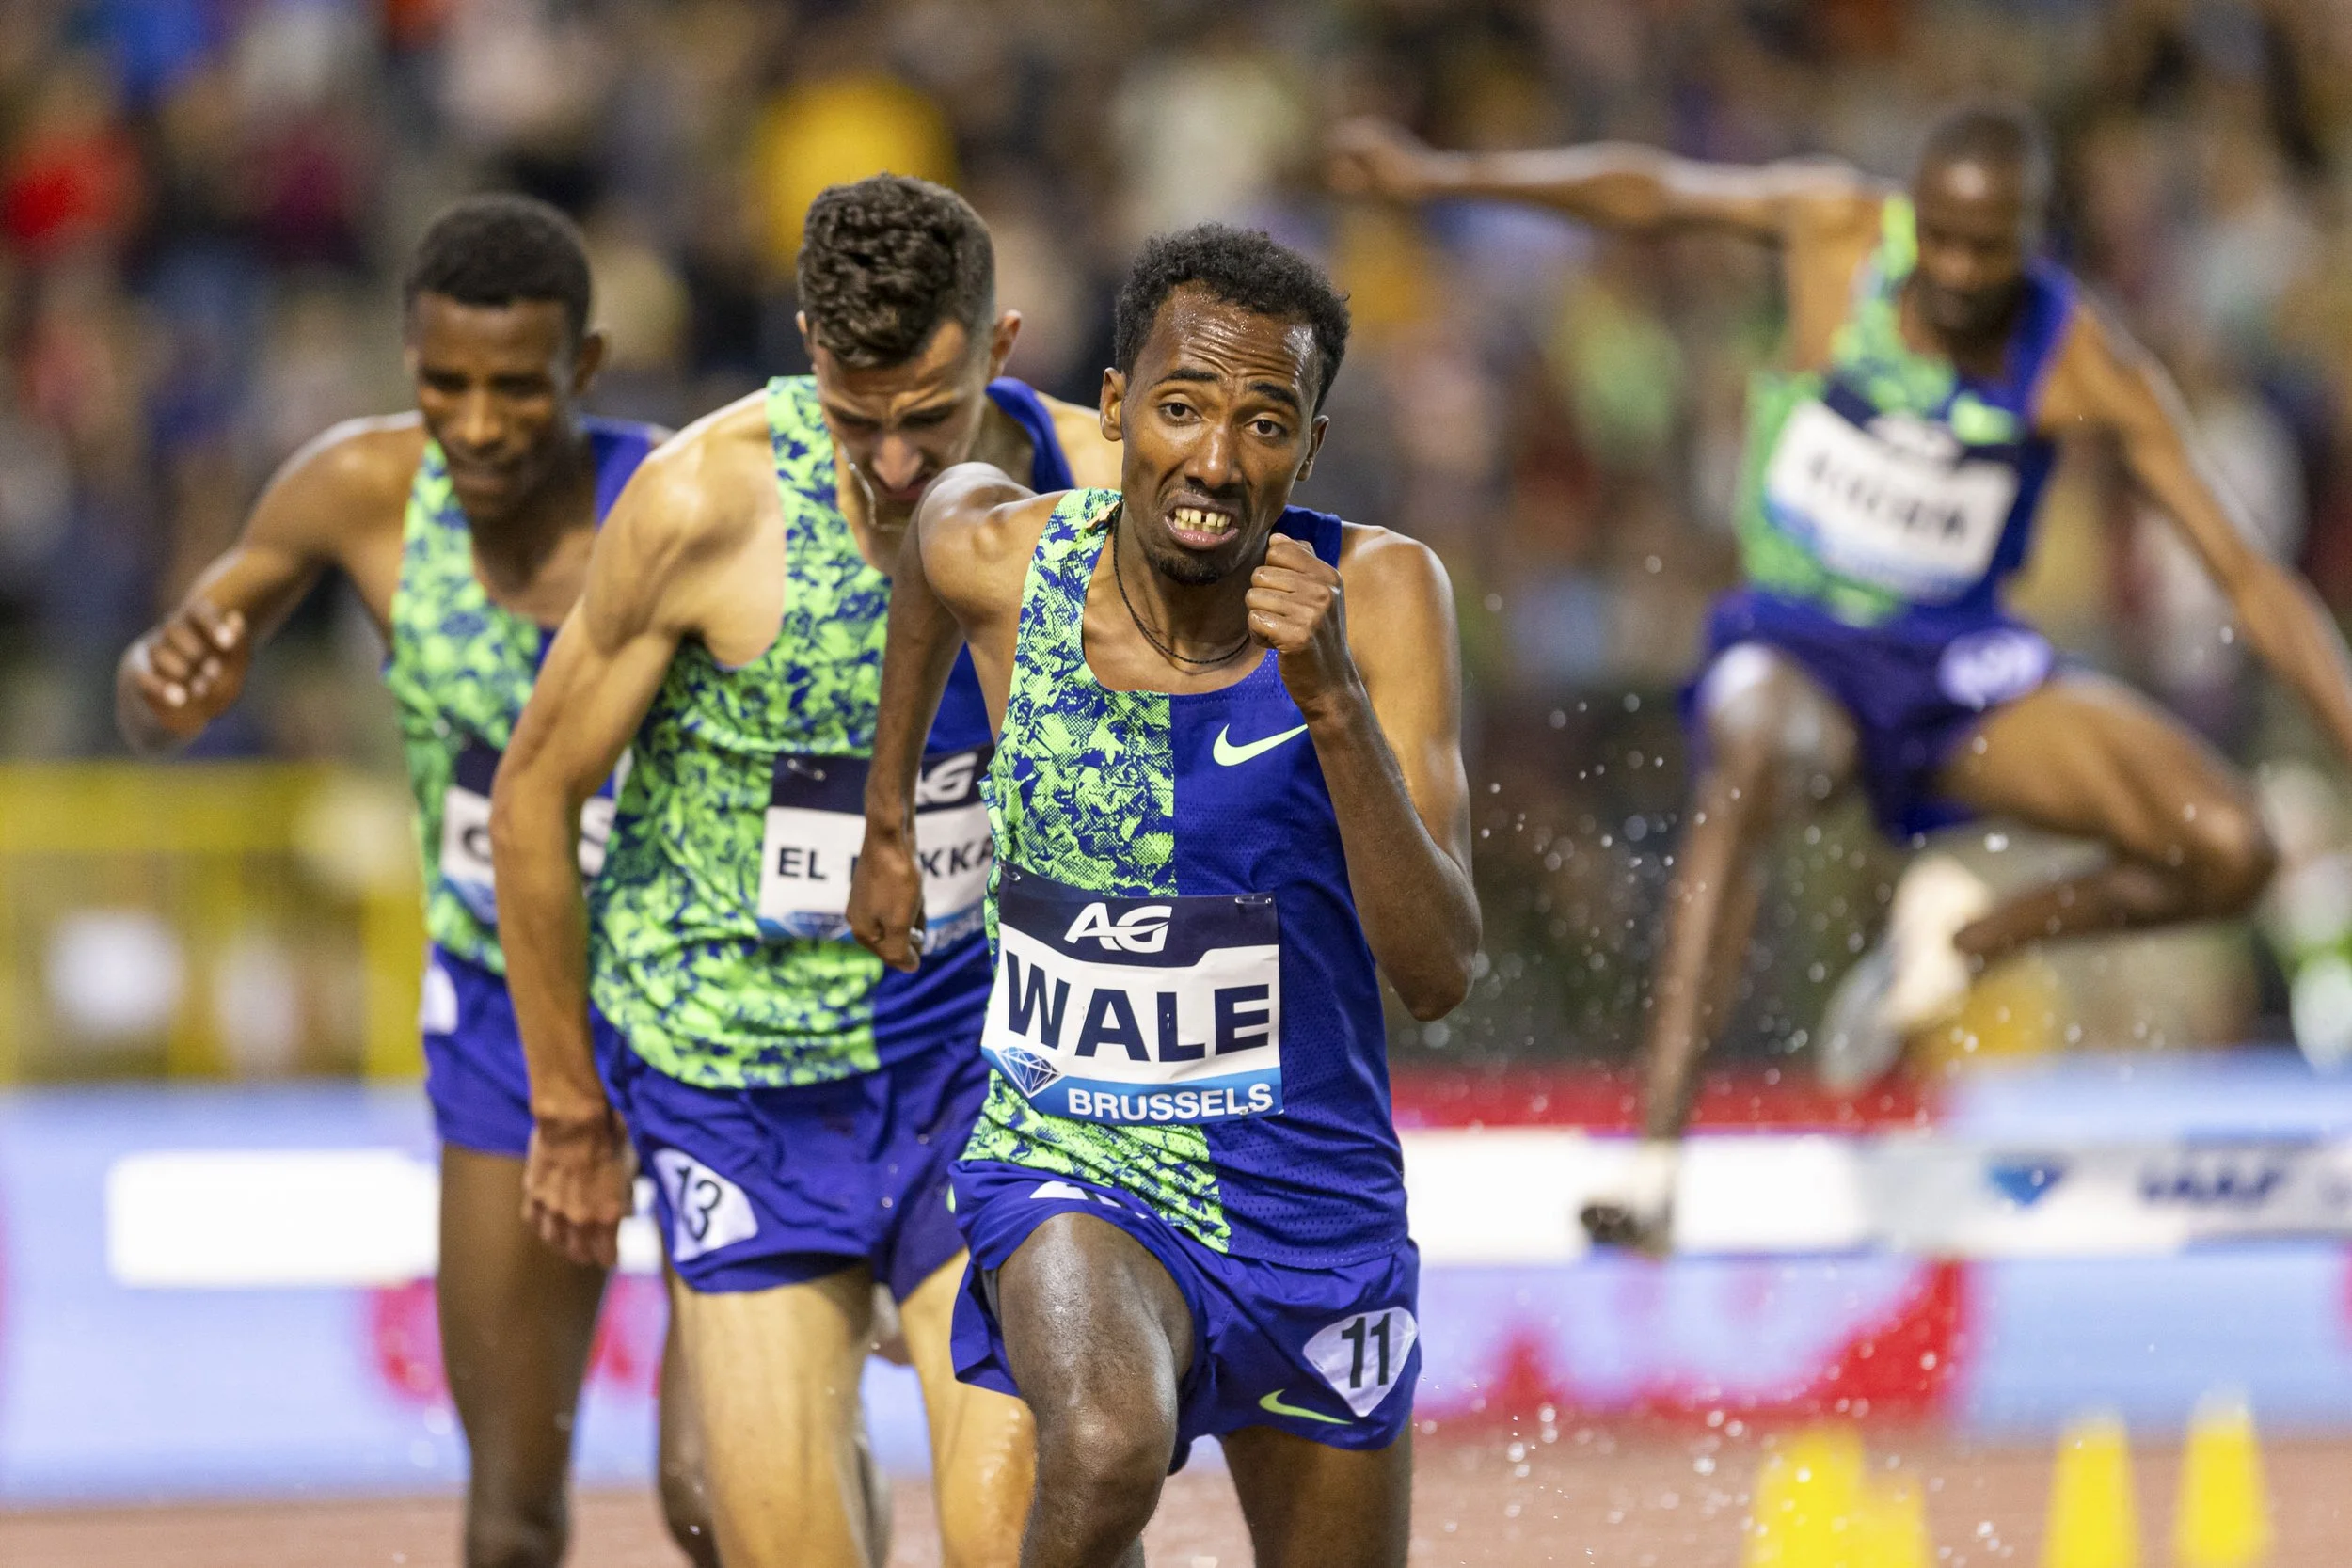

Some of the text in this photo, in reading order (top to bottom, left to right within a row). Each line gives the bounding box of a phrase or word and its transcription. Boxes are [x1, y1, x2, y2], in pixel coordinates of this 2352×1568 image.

[914, 752, 978, 807] G
[777, 846, 828, 880] EL
[1064, 902, 1173, 954] AG
[1005, 949, 1270, 1063] WALE
[1067, 1083, 1274, 1121] BRUSSELS
[675, 1165, 723, 1242] 13
[1341, 1311, 1391, 1389] 11
